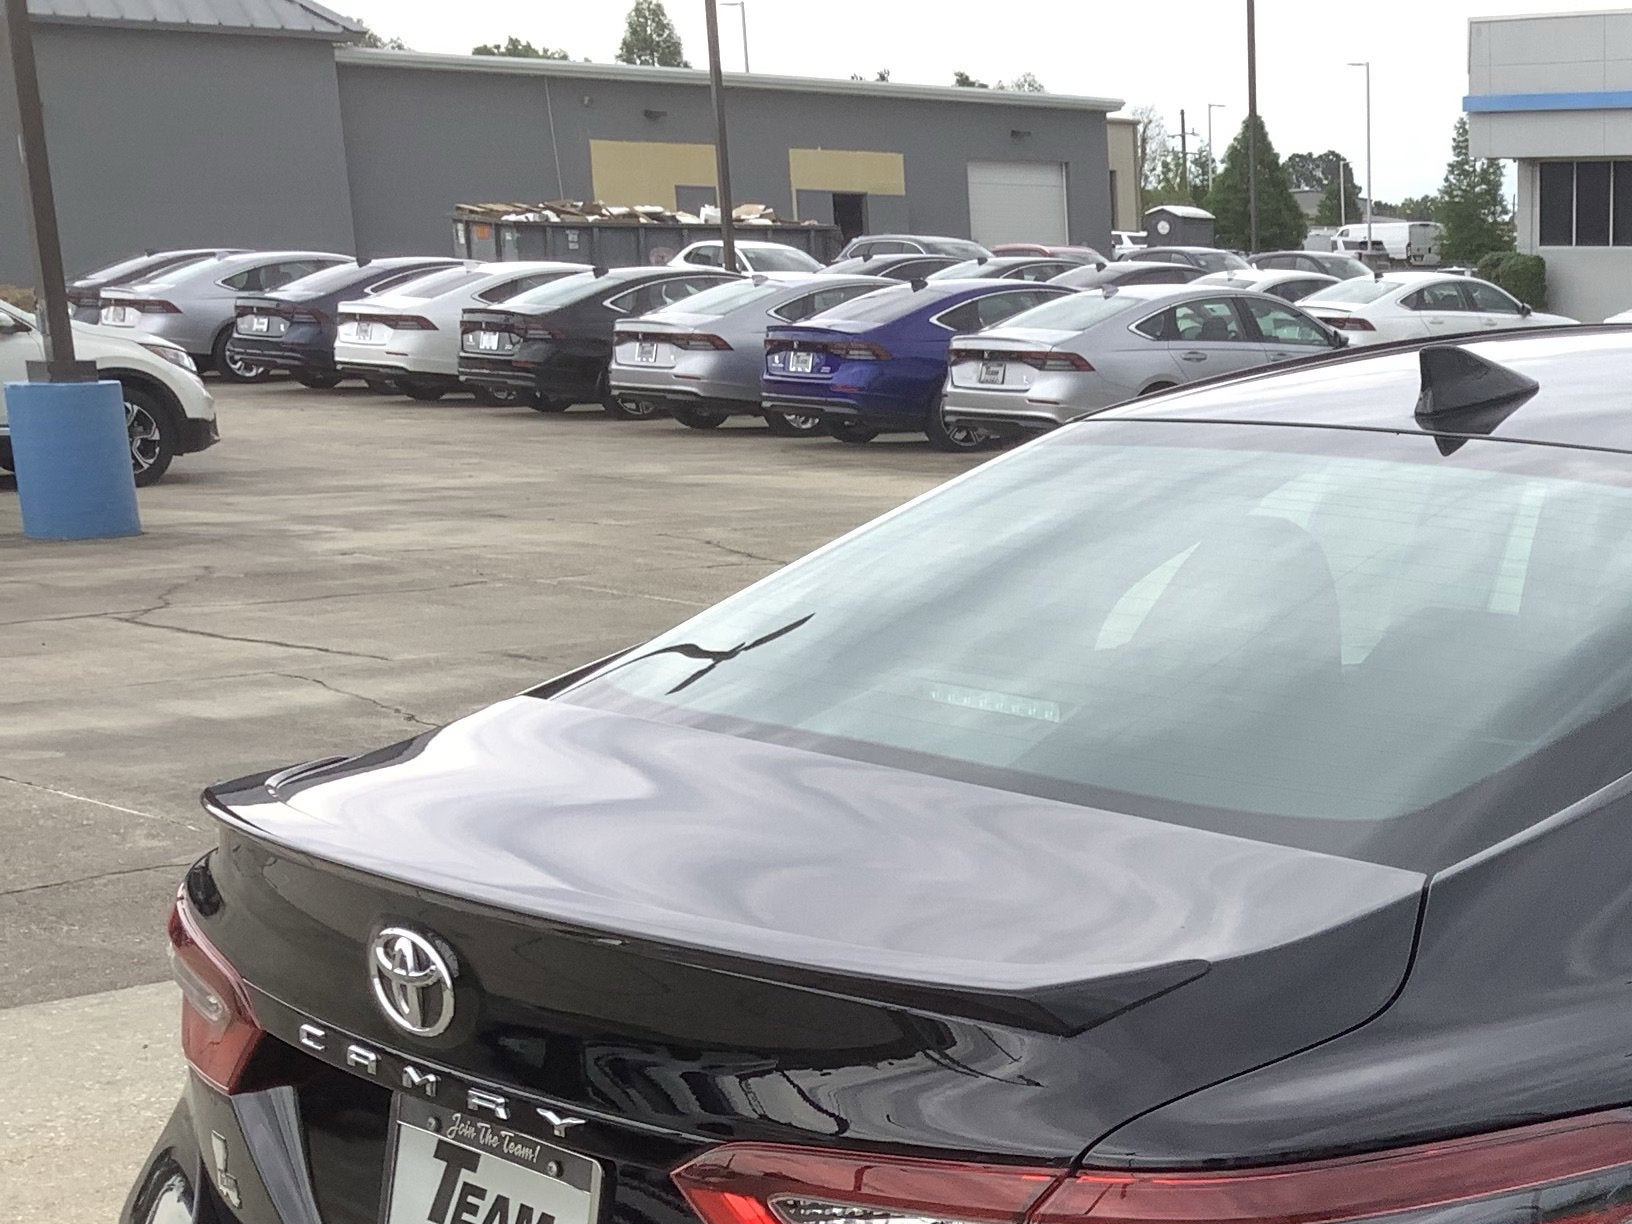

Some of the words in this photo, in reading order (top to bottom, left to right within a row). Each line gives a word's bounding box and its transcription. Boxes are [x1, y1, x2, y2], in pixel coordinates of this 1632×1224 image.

[299, 1022, 588, 1138] CAMRY
[446, 1112, 477, 1140] Join
[475, 1121, 500, 1149] The
[499, 1130, 541, 1164] Team!
